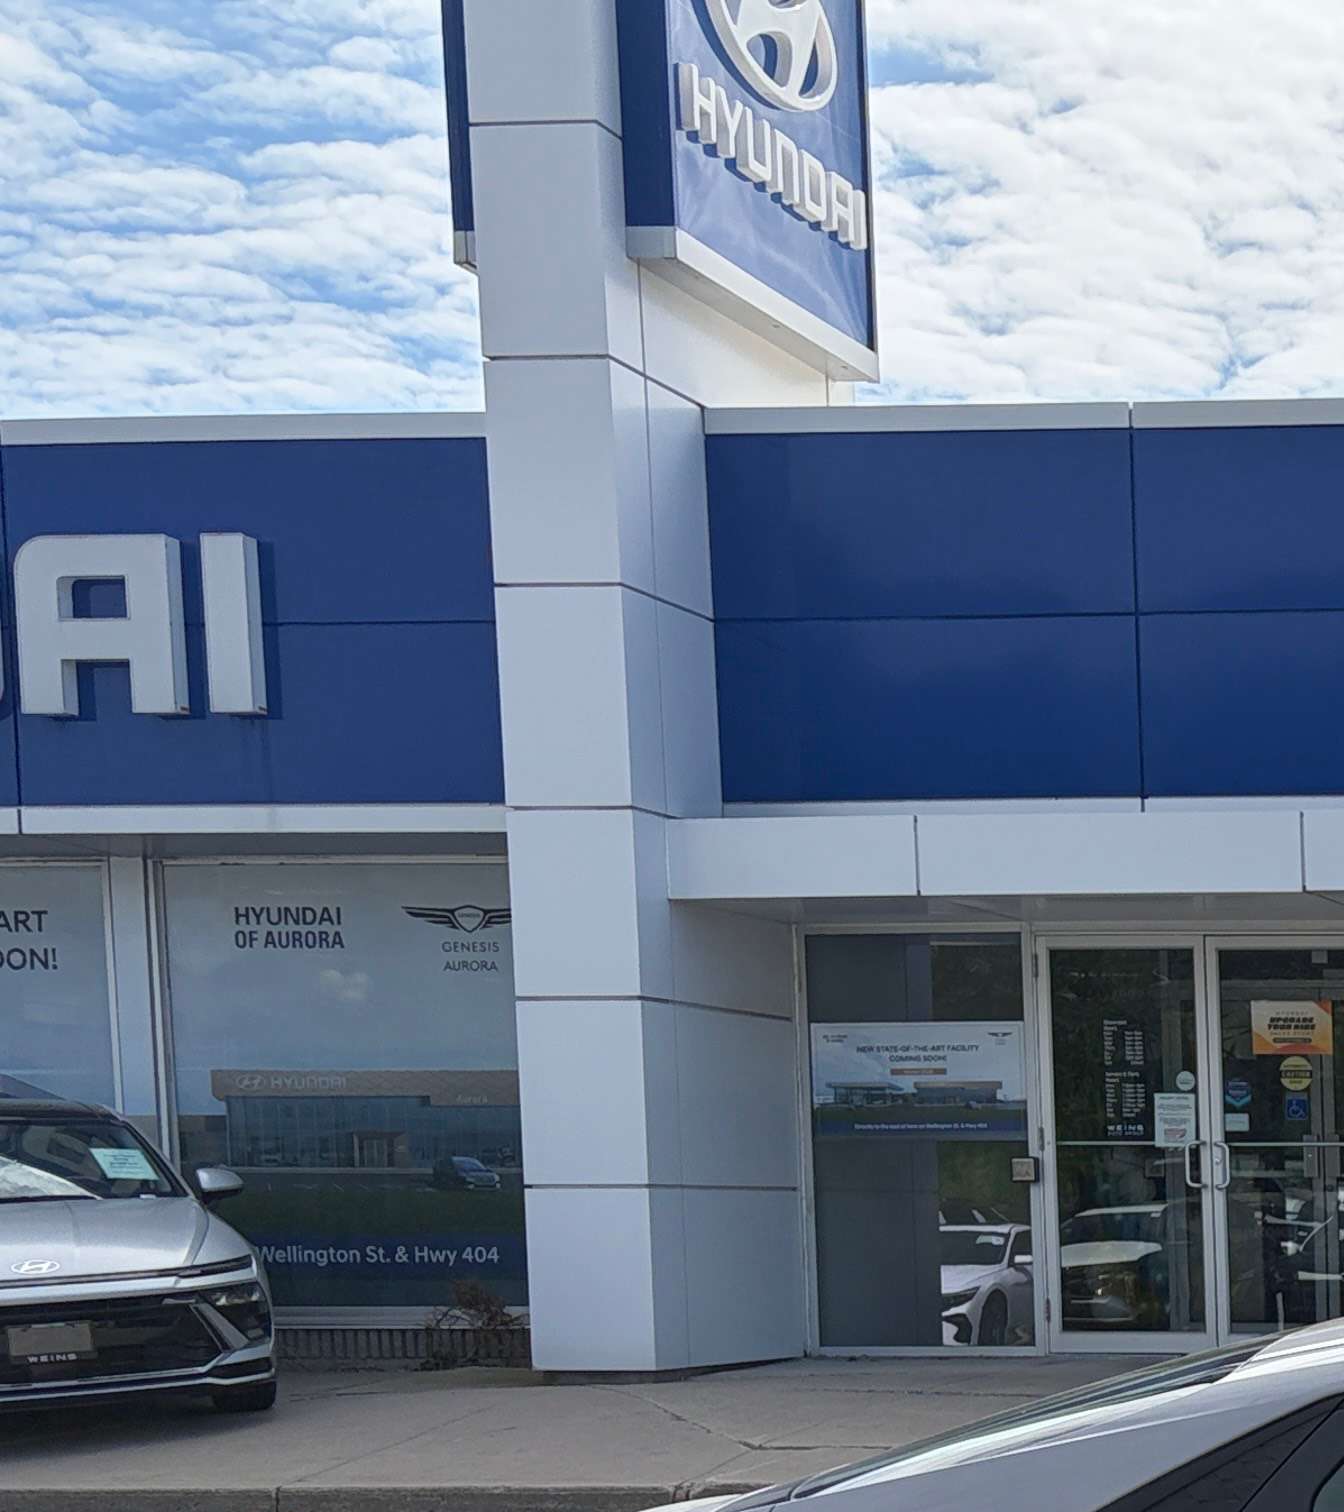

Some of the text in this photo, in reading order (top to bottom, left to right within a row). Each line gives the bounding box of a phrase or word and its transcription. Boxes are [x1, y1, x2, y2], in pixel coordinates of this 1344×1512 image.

[675, 62, 868, 250] HYUNDAI
[0, 532, 268, 716] AI
[234, 906, 342, 926] HYUNDAI
[234, 930, 345, 949] OF AURORA
[441, 941, 500, 953] GENESIS
[0, 947, 58, 971] OON!
[443, 960, 498, 972] AURORA
[256, 1245, 500, 1267] Wellington St. & Hwy 404
[26, 1352, 78, 1364] WEINS
